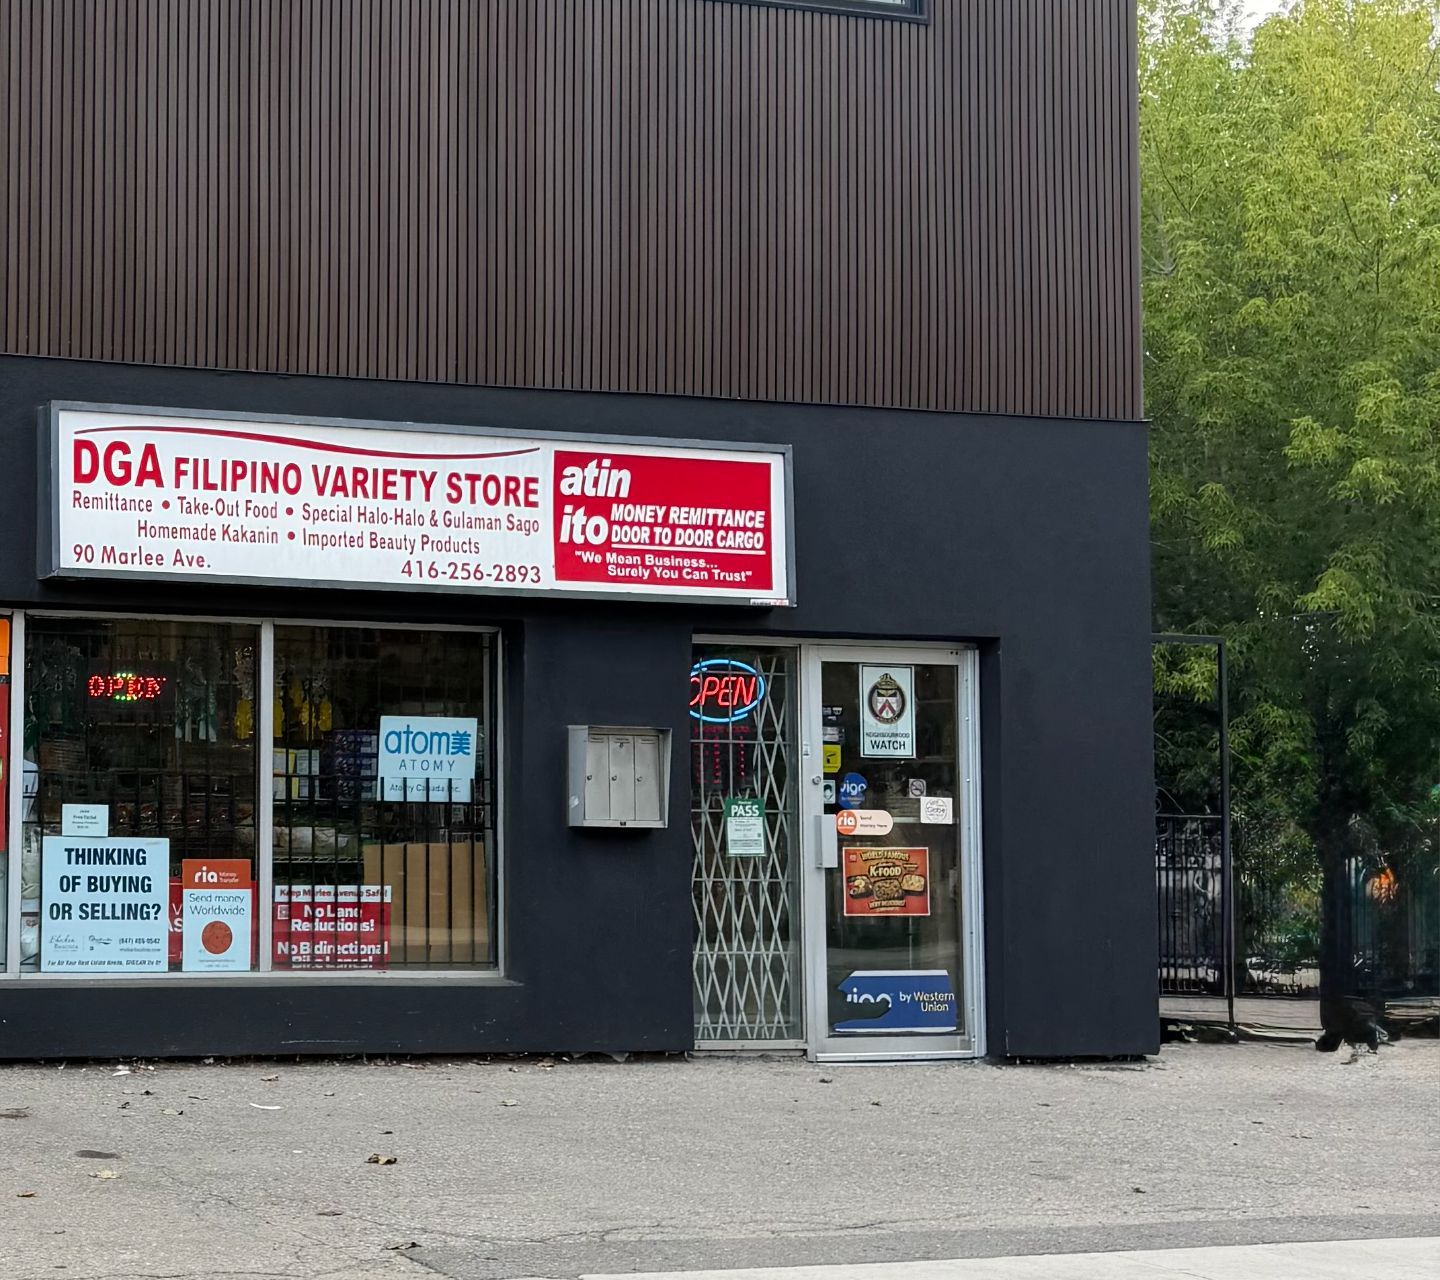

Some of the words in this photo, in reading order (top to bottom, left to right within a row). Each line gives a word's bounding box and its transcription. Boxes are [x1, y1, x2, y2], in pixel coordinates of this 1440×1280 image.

[73, 438, 165, 488] DGA
[174, 456, 302, 496] FILIPINO
[311, 464, 438, 502] VARIETY
[446, 471, 540, 508] STORE
[559, 458, 632, 498] atin
[72, 490, 153, 512] Remittance
[177, 496, 239, 517] Take-Out
[245, 499, 278, 519] Food
[302, 503, 352, 525] Special
[357, 506, 425, 527] Halo-Halo
[429, 510, 439, 527] &
[443, 510, 502, 532] Gulaman
[506, 513, 540, 536] Sago
[559, 504, 609, 545] ito
[611, 503, 667, 523] MONEY
[668, 507, 766, 528] REMITTANCE
[137, 519, 216, 541] Homemade
[221, 524, 279, 544] Kakanin
[303, 528, 364, 551] Imported
[369, 532, 416, 555] Beauty
[421, 534, 480, 554] Products
[611, 524, 650, 544] DOOR
[653, 526, 672, 545] TO
[675, 528, 714, 547] DOOR
[716, 530, 764, 549] CARGO
[73, 543, 95, 564] 90
[101, 545, 164, 567] Marlee
[172, 548, 211, 569] Ave.
[401, 560, 541, 584] 416-256-2893
[574, 550, 602, 564] "We
[606, 552, 641, 566] Mean
[645, 554, 718, 569] Business...
[607, 564, 650, 580] Surely
[653, 566, 678, 579] You
[682, 568, 709, 580] Can
[712, 569, 752, 582] Trust"
[870, 739, 906, 751] WATCH
[398, 759, 455, 772] ATOMY
[730, 804, 760, 817] PASS
[837, 812, 856, 826] ria
[64, 847, 147, 866] THINKING
[194, 865, 218, 883] ria
[870, 865, 902, 877] K-FOOD
[59, 875, 82, 893] OF
[87, 875, 152, 893] BUYING
[189, 892, 212, 903] Send
[214, 894, 245, 904] money
[49, 902, 73, 920] OR
[78, 903, 162, 921] SELLING?
[189, 904, 246, 916] Worldwide
[303, 904, 324, 918] No
[277, 941, 298, 955] No
[899, 991, 912, 1003] by
[913, 991, 955, 1002] Western
[920, 1002, 949, 1012] Union
